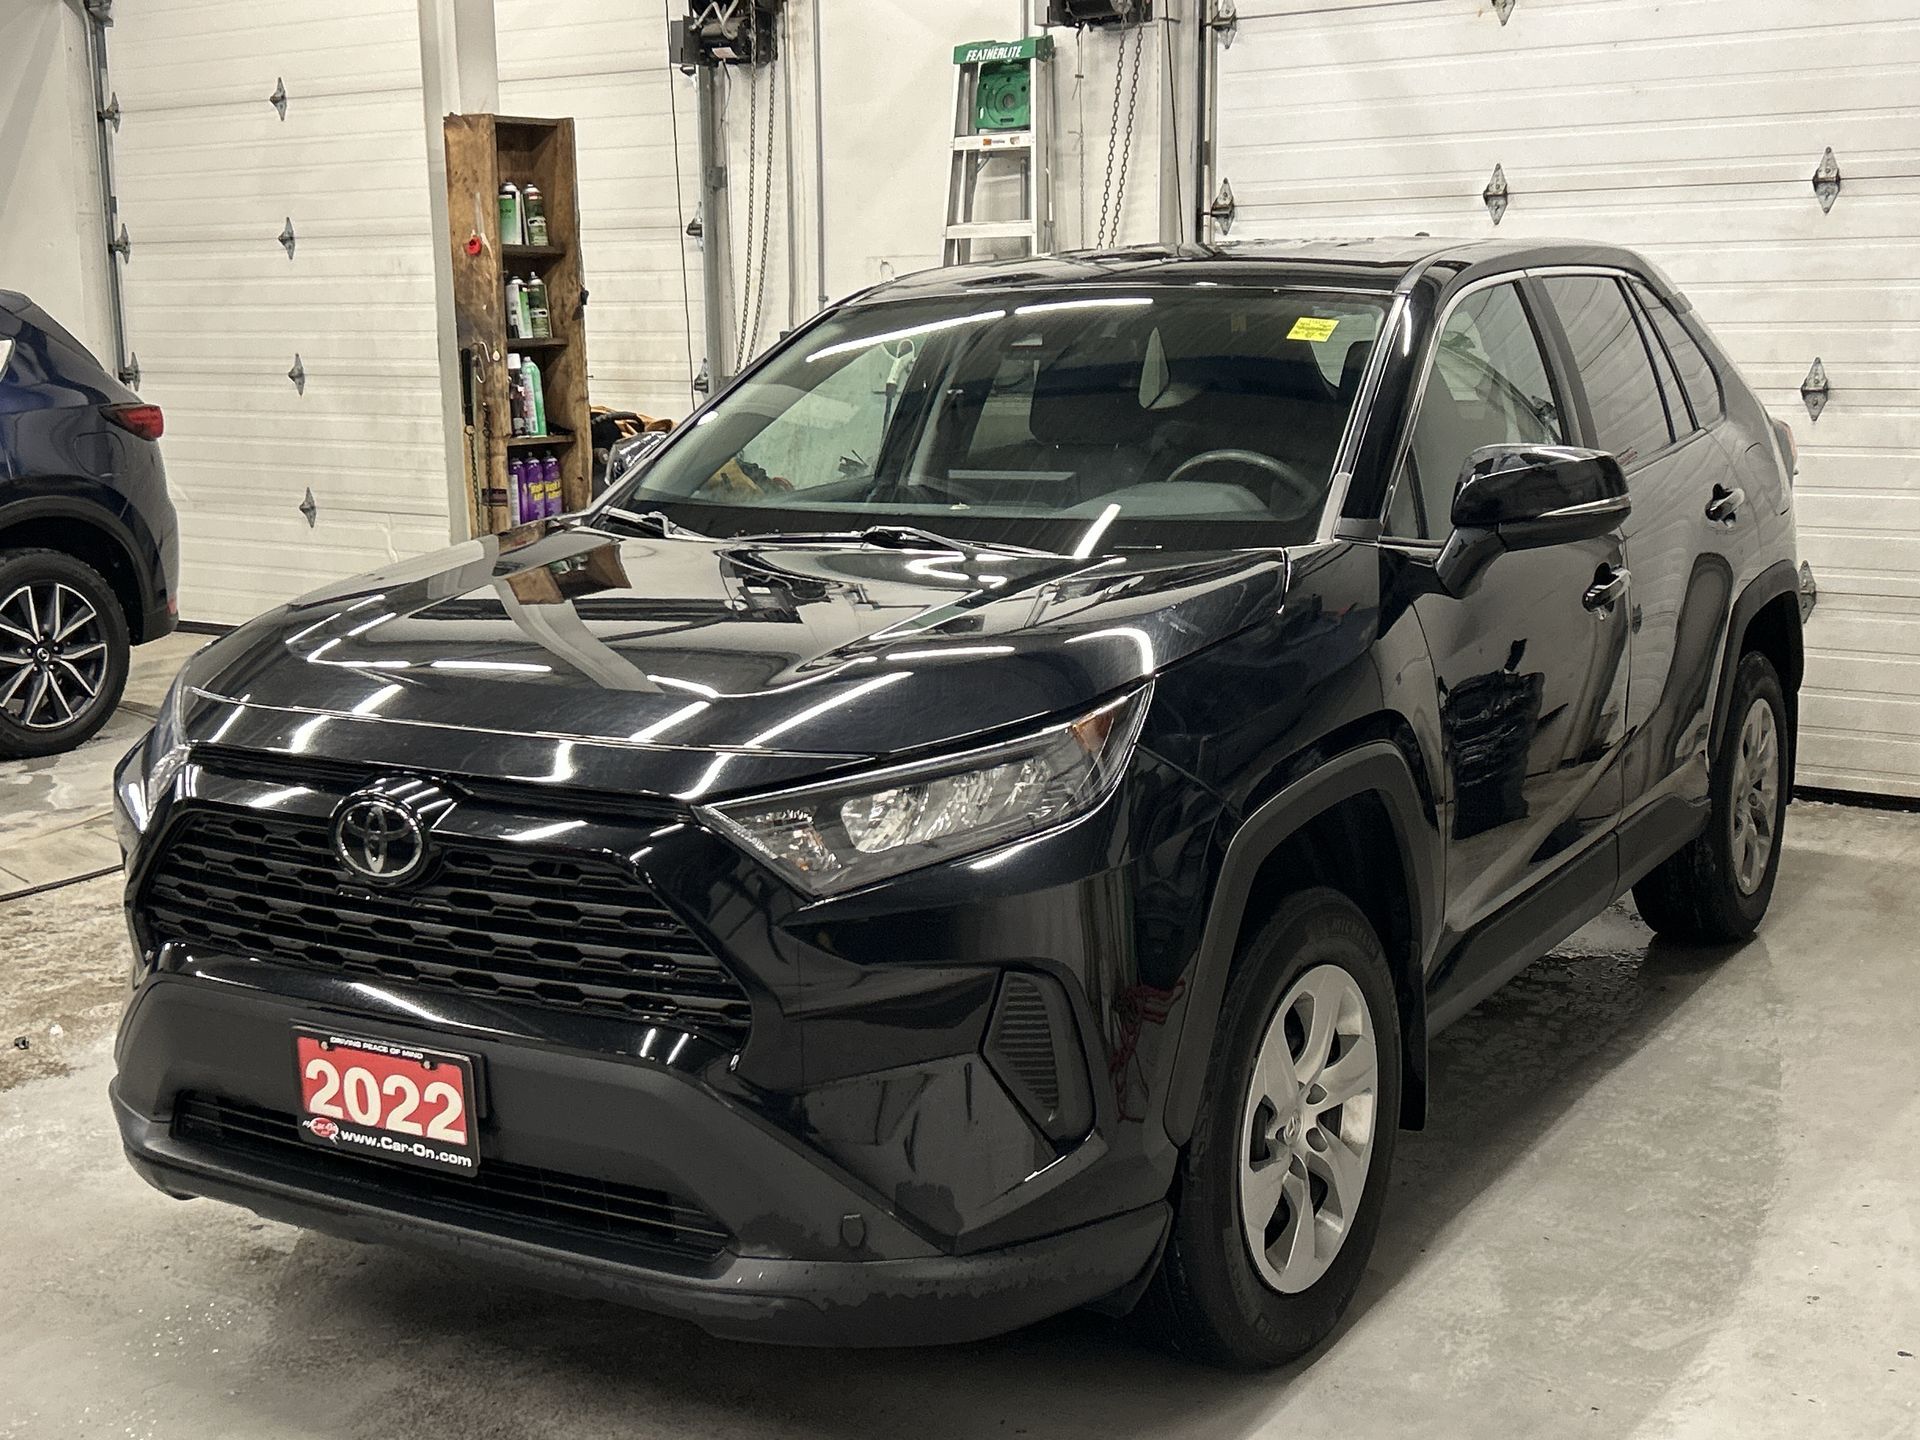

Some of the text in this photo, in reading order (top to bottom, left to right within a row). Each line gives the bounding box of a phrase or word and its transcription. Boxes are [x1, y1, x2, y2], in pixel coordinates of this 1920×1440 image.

[965, 45, 1023, 61] FEATHERLITE
[362, 1042, 389, 1053] PEACE
[389, 1047, 402, 1055] OF
[401, 1050, 424, 1059] MIND
[305, 1058, 466, 1146] 2022
[340, 1130, 472, 1168] www.Car-On.com
